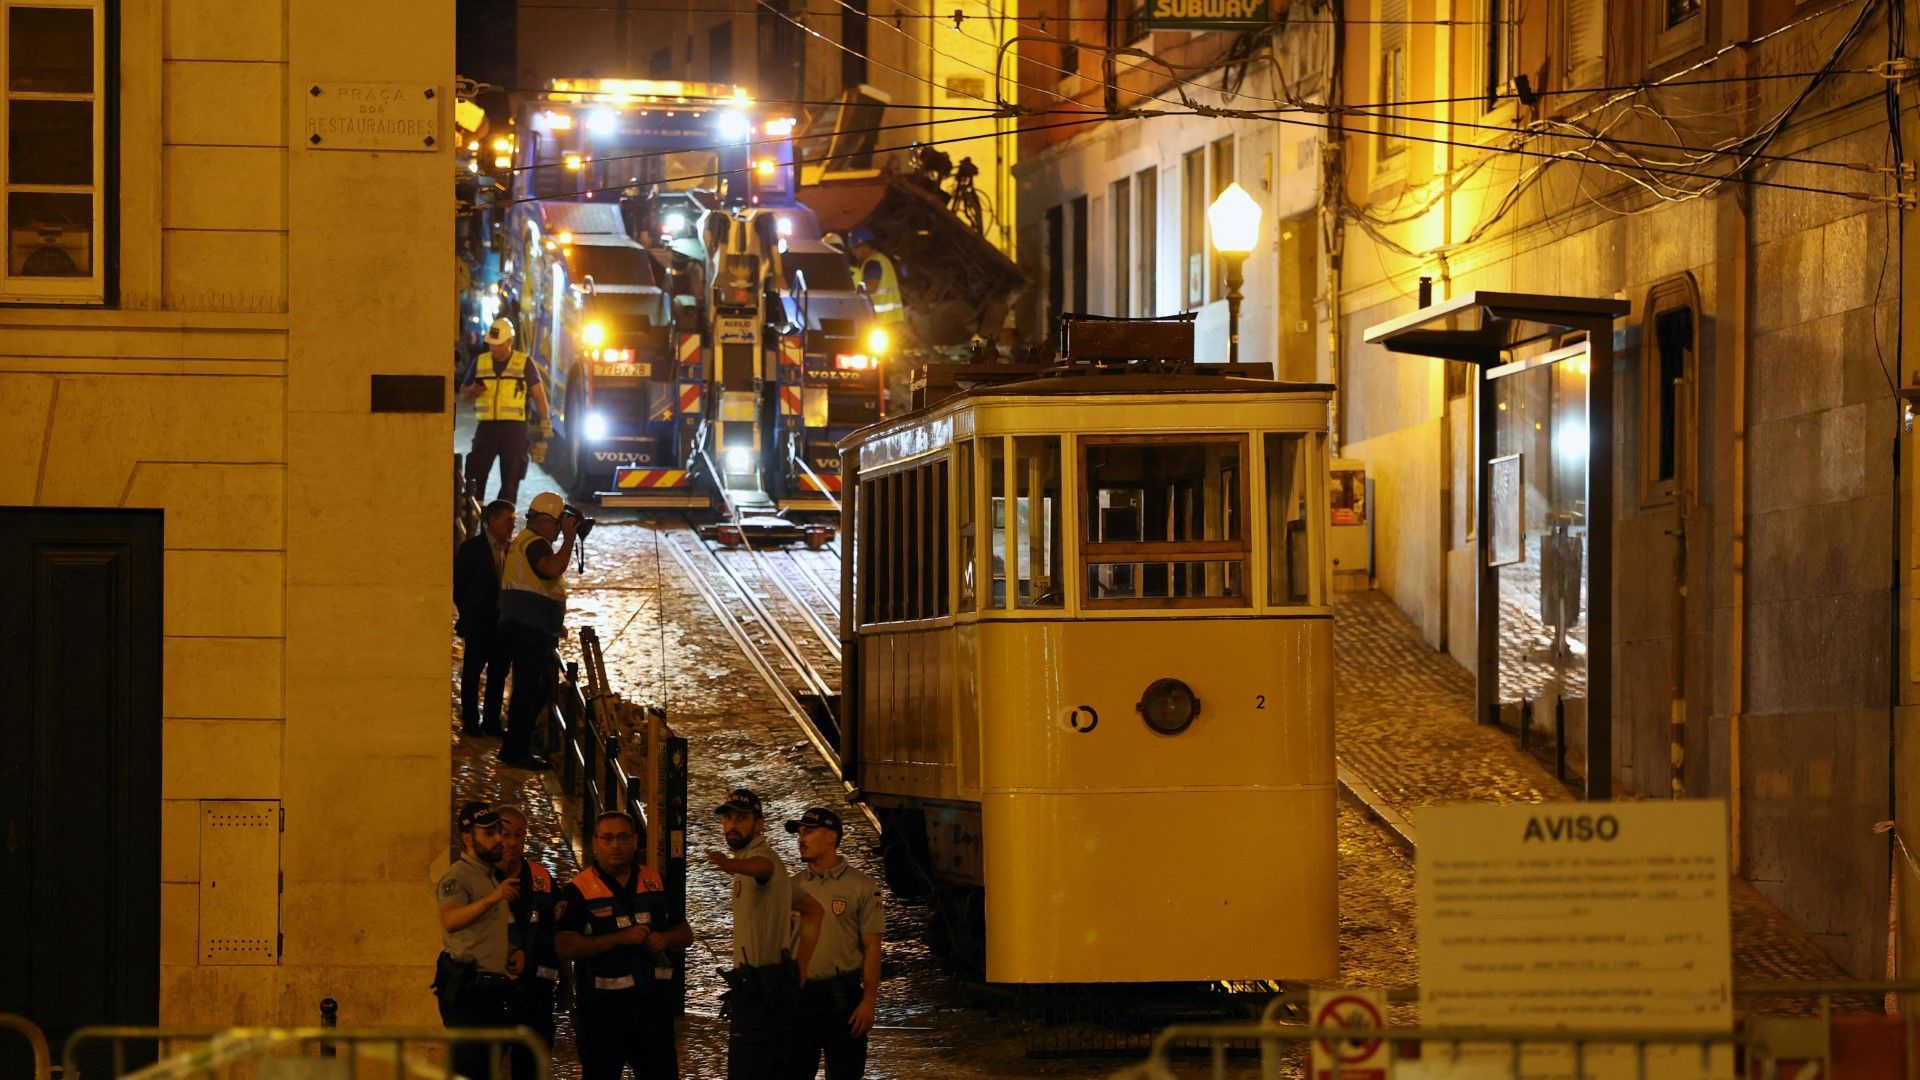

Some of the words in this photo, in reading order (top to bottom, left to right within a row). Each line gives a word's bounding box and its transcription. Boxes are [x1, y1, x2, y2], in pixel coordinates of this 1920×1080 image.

[1153, 0, 1258, 18] SUBWAY
[338, 87, 407, 104] PRAÇA
[359, 105, 385, 114] DOS
[308, 117, 436, 135] RESTAURADORES
[808, 370, 860, 380] VOLVO
[593, 452, 651, 463] VOLVO
[1255, 694, 1265, 709] 2
[1523, 814, 1619, 842] AVISO
